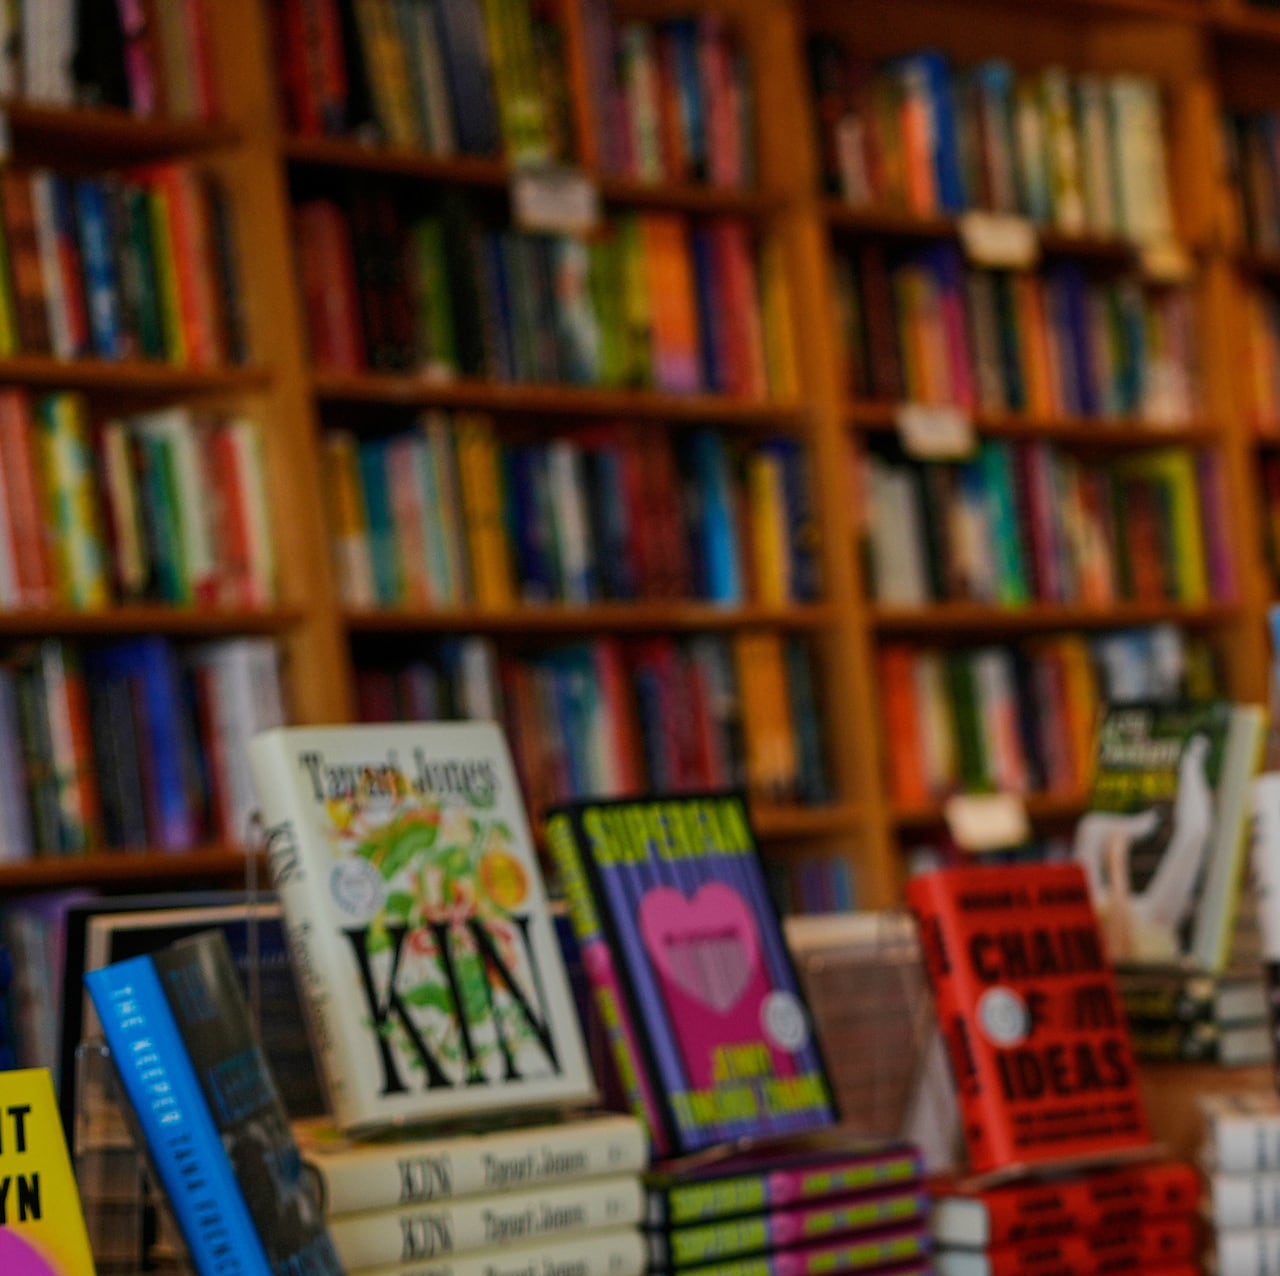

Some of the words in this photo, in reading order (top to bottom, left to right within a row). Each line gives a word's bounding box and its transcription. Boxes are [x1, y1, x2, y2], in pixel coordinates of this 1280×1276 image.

[969, 925, 1107, 983] CHAIN
[340, 912, 566, 1097] KIN
[996, 1040, 1131, 1101] IDEAS
